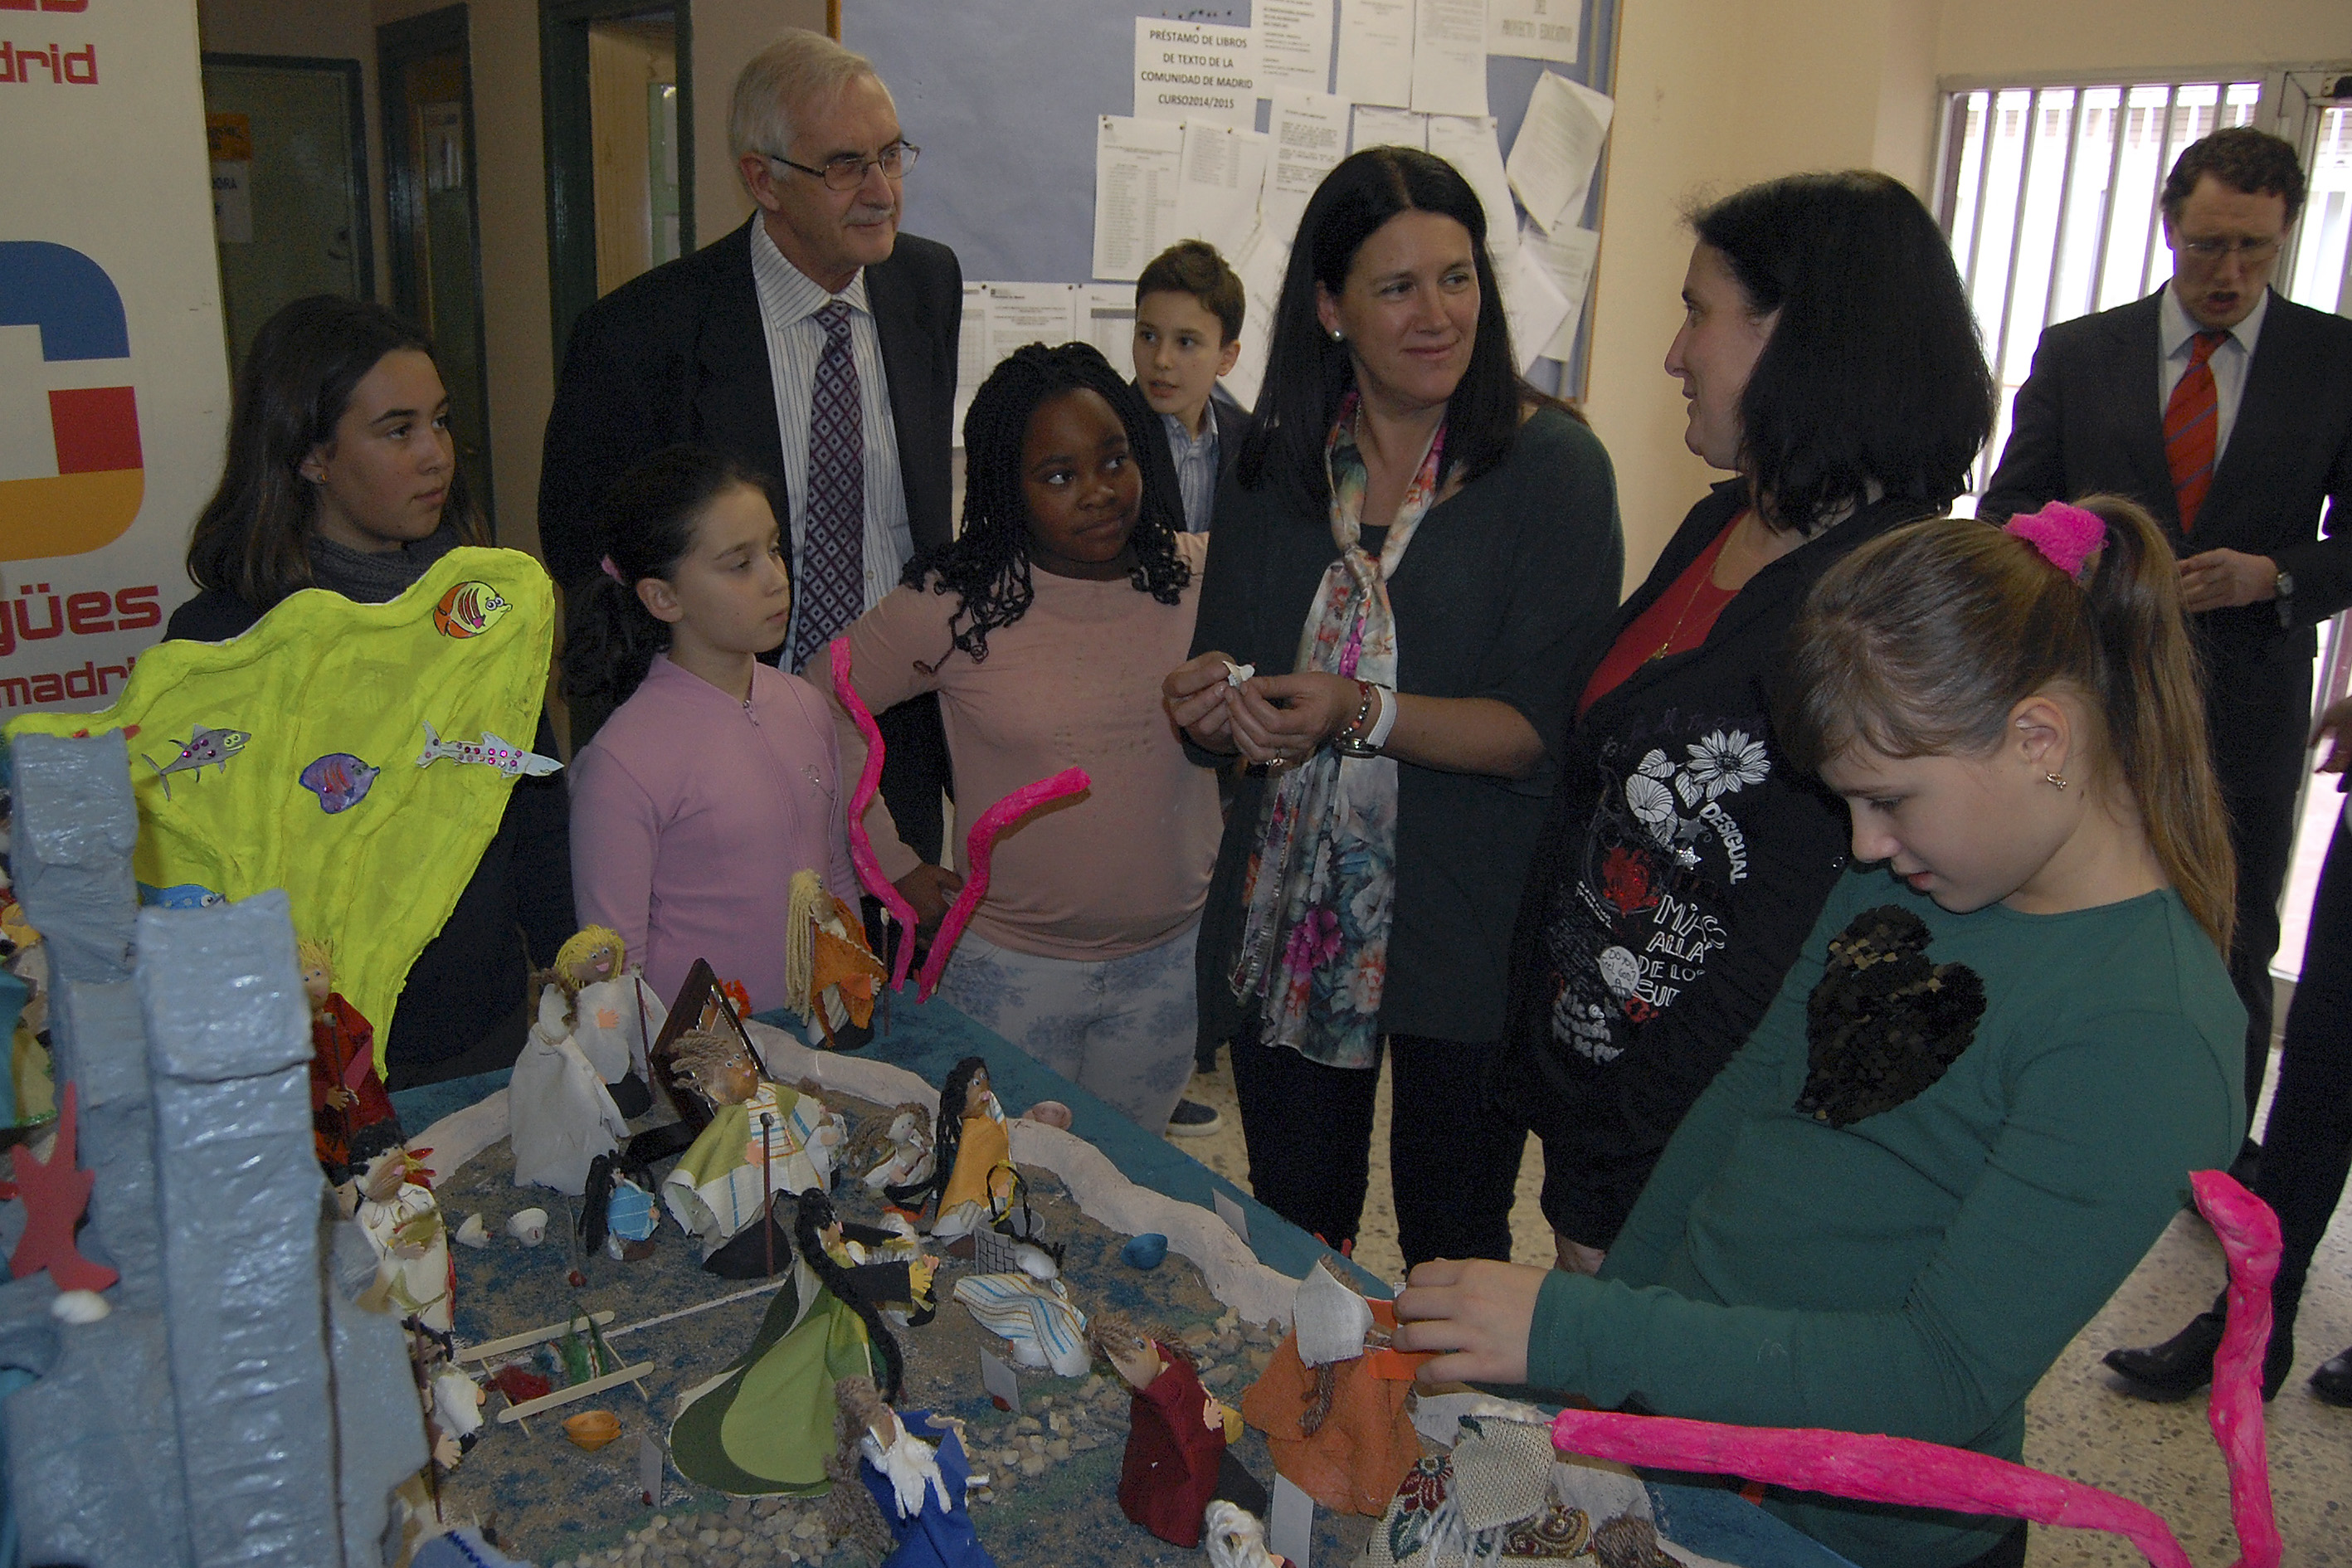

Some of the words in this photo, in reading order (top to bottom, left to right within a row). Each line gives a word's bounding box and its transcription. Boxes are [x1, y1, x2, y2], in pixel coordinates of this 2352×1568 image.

[1149, 29, 1200, 44] PRÉSTAMO
[1202, 35, 1214, 45] DE
[1216, 37, 1248, 48] LIBROS
[1163, 53, 1175, 63] DE
[1178, 54, 1206, 66] TEXTO
[1209, 56, 1220, 66] DE
[1223, 58, 1234, 68] LA
[1141, 71, 1200, 85] COMUNIDAD
[1203, 75, 1214, 86] DE
[1216, 77, 1253, 89] MADRID
[1158, 94, 1234, 109] CURSO2014/2015
[1699, 801, 1749, 885] DESIGUAL
[1638, 955, 1666, 978] DE
